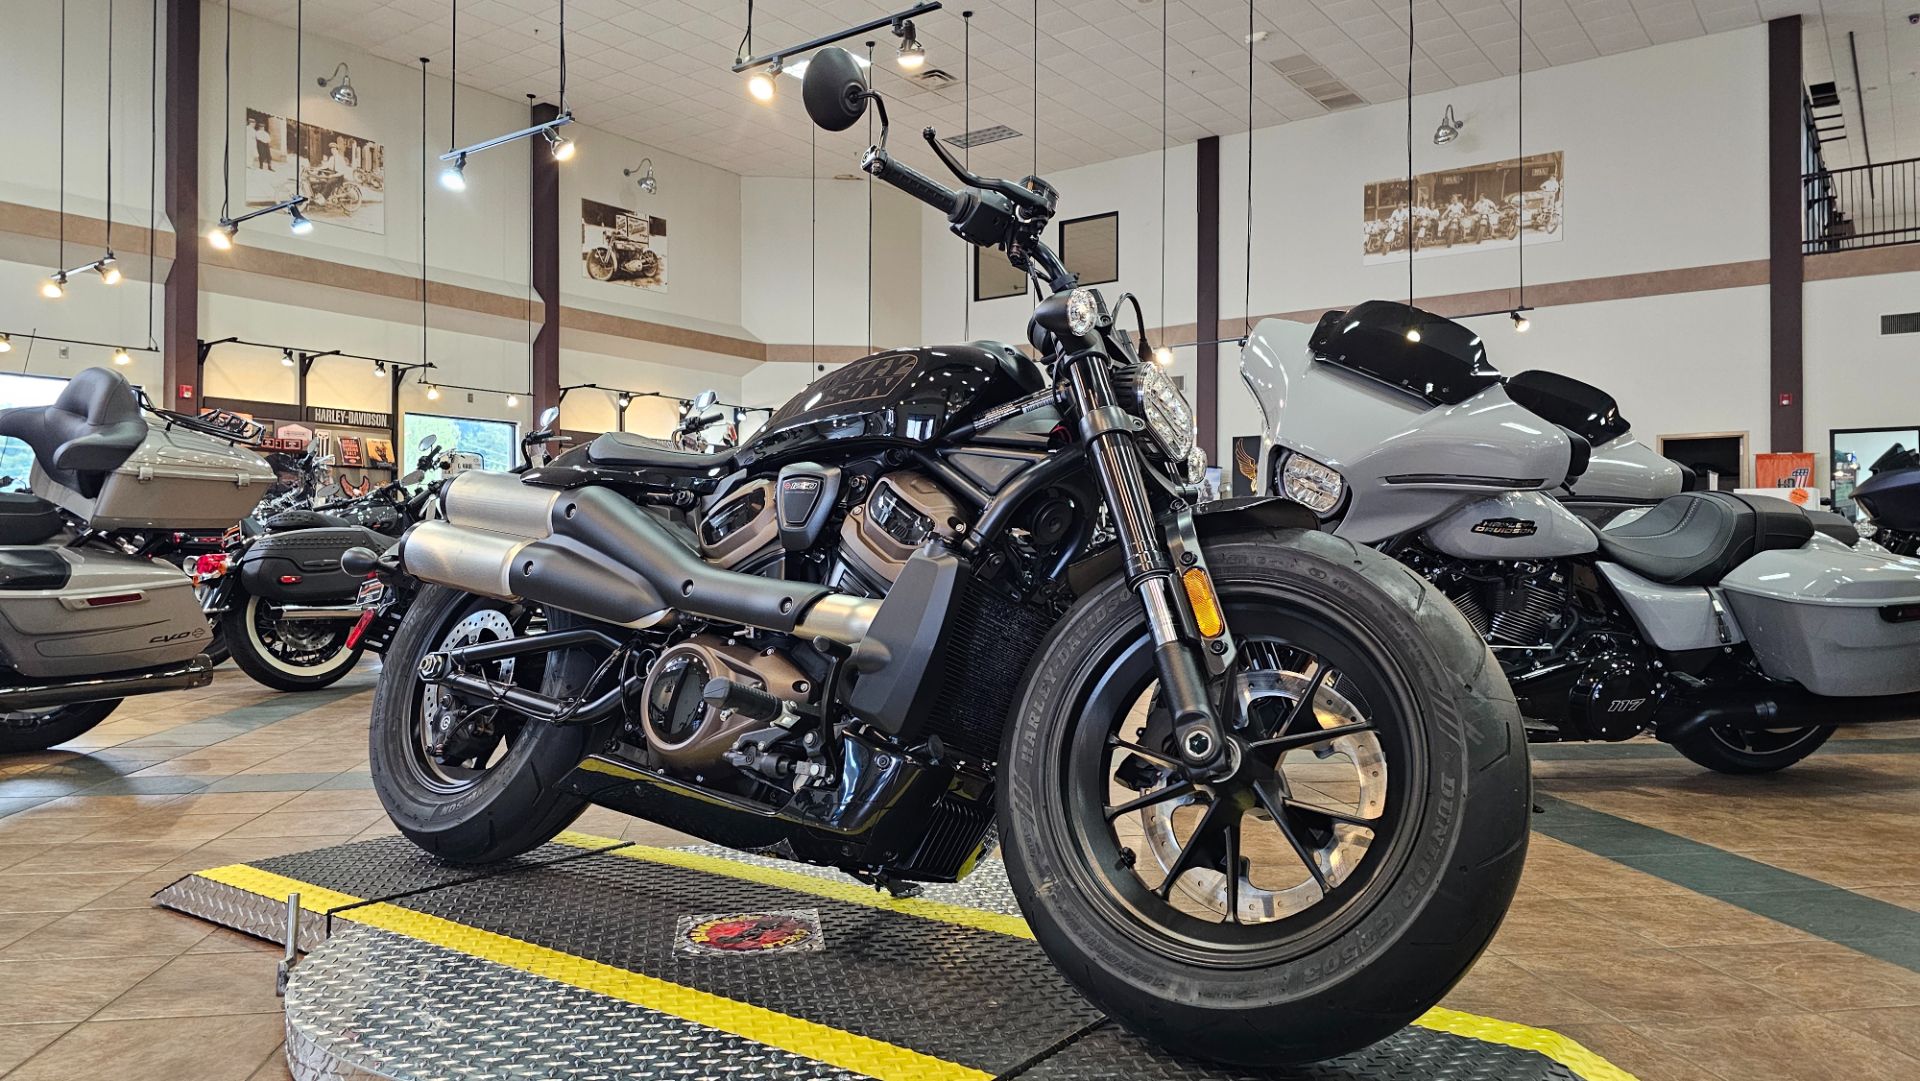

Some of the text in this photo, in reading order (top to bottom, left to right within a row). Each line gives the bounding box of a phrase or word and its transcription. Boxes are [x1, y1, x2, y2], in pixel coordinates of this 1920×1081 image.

[315, 408, 387, 427] HARLEY-DAVIDSON
[1608, 698, 1646, 712] 117
[1401, 771, 1456, 908] DUNLOP
